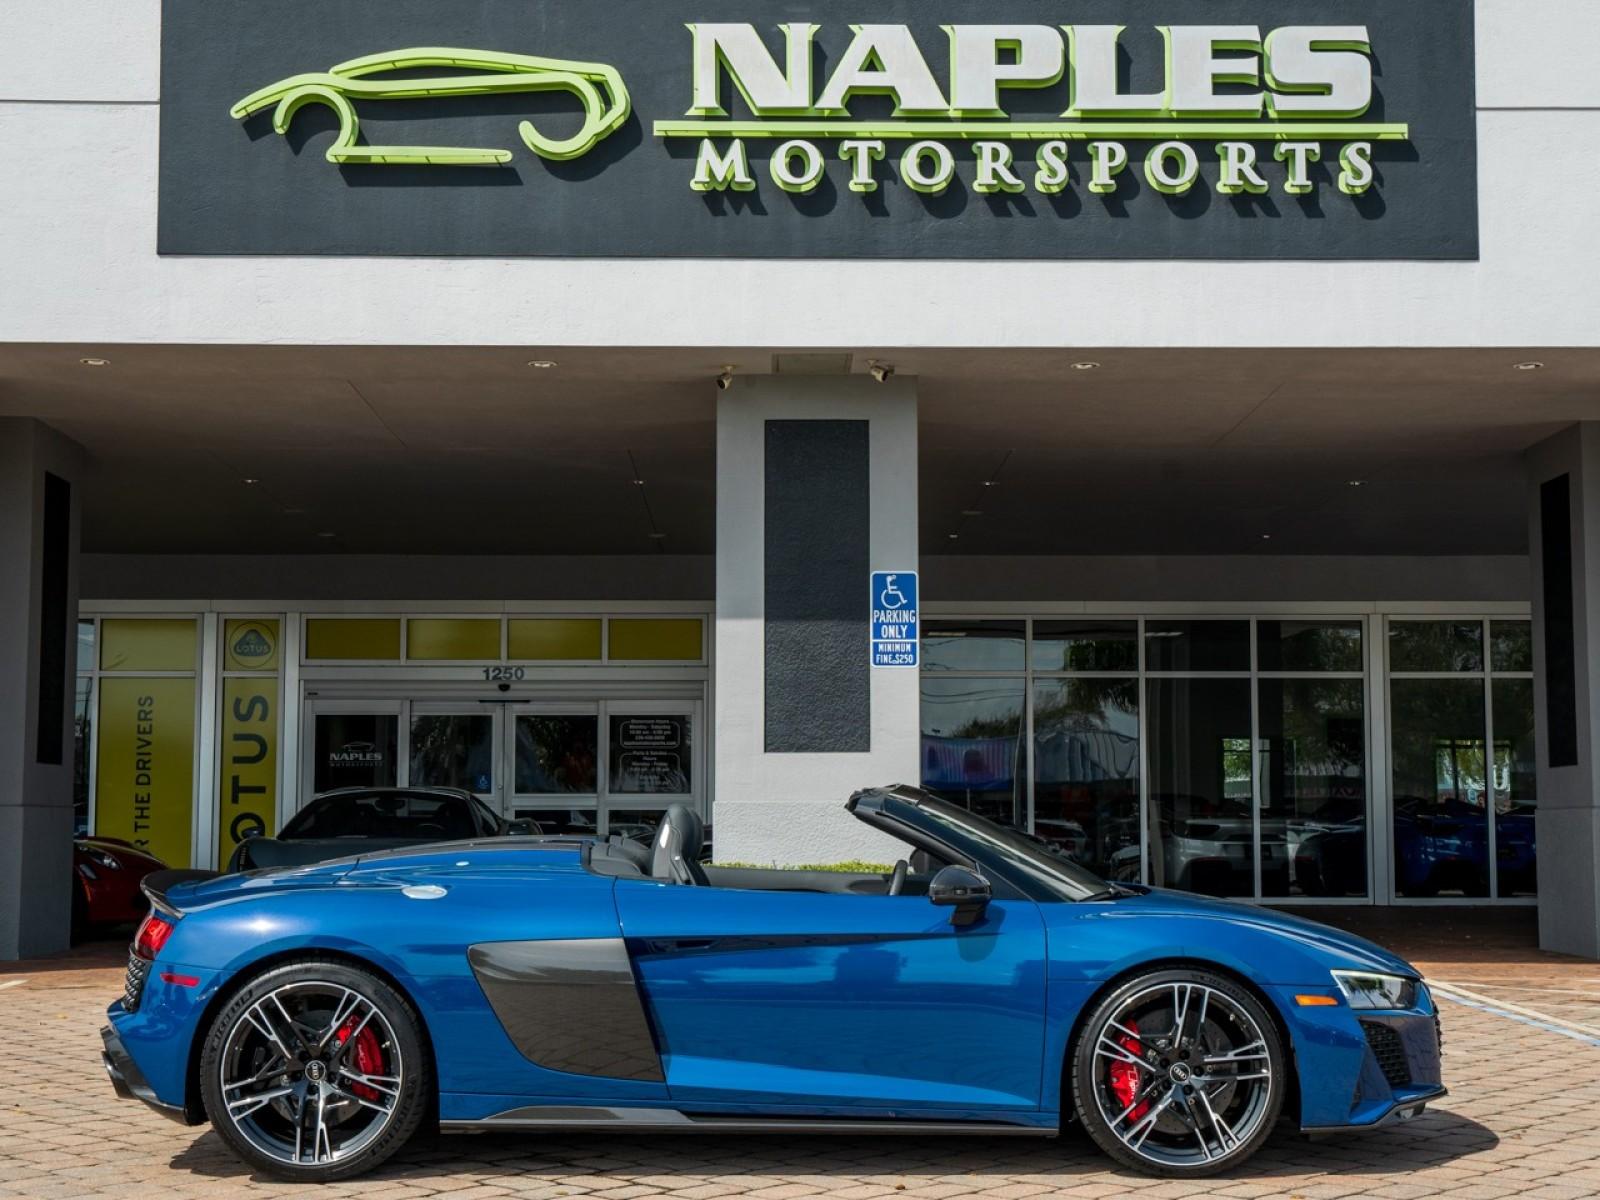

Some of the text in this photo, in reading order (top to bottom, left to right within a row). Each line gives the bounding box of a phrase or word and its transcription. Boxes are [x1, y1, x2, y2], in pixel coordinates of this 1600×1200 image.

[686, 22, 1372, 118] NAPLES
[690, 140, 1373, 194] MOTORSPORTS
[873, 610, 916, 623] PARKING
[881, 625, 908, 639] ONLY
[878, 643, 911, 652] MINIMUM
[876, 654, 914, 664] FINE $250
[482, 666, 525, 681] 1250
[135, 695, 154, 786] DRIVERS
[329, 752, 383, 760] NAPLES
[134, 793, 151, 832] THE
